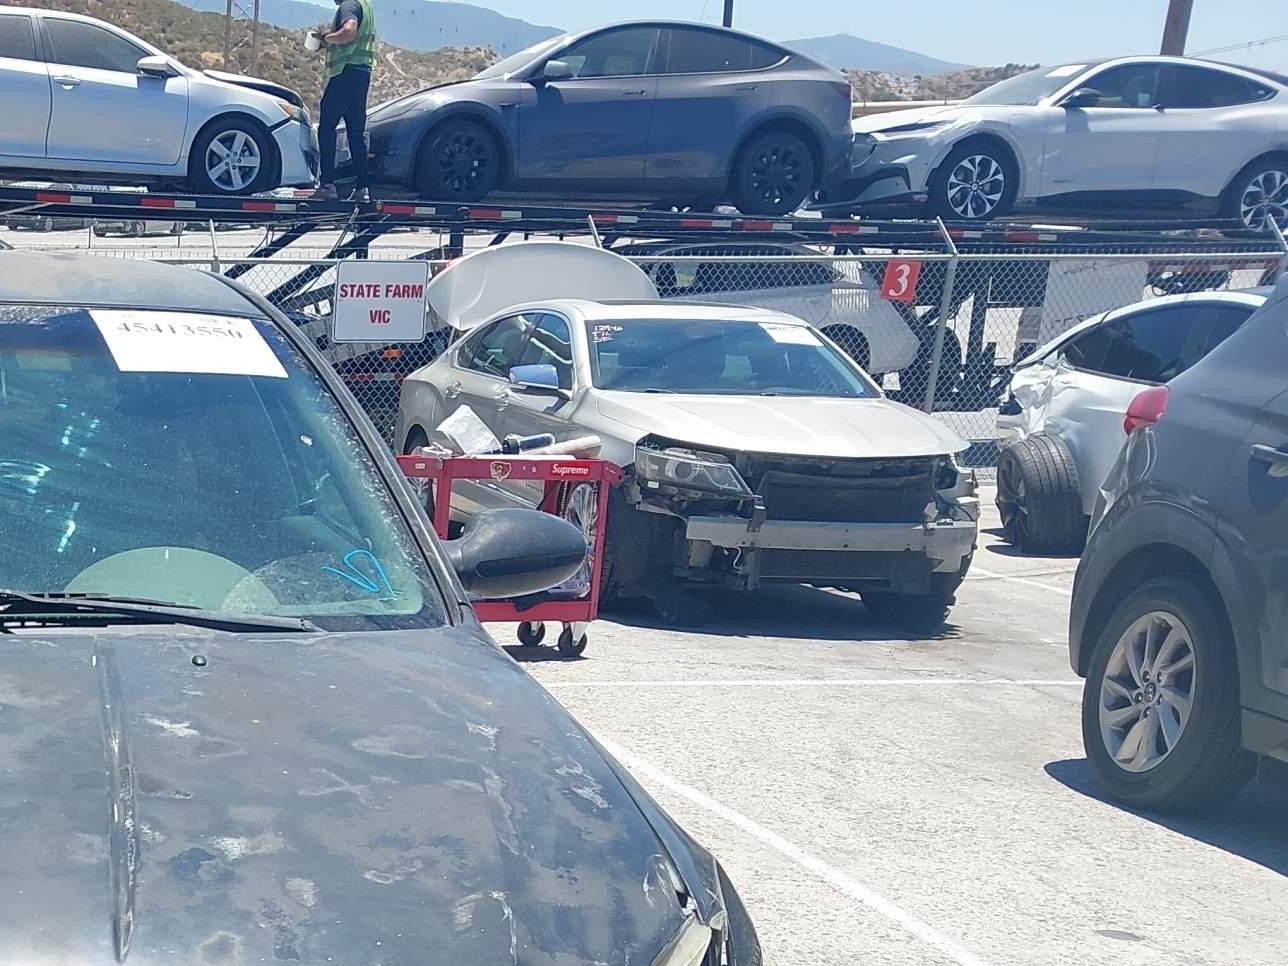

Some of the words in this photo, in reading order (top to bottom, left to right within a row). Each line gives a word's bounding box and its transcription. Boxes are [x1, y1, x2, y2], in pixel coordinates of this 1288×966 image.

[888, 264, 911, 297] 3
[339, 283, 381, 299] STATE
[384, 284, 424, 299] FARM
[369, 309, 391, 324] VIC
[116, 321, 244, 340] 45413550
[551, 463, 589, 476] Supreme
